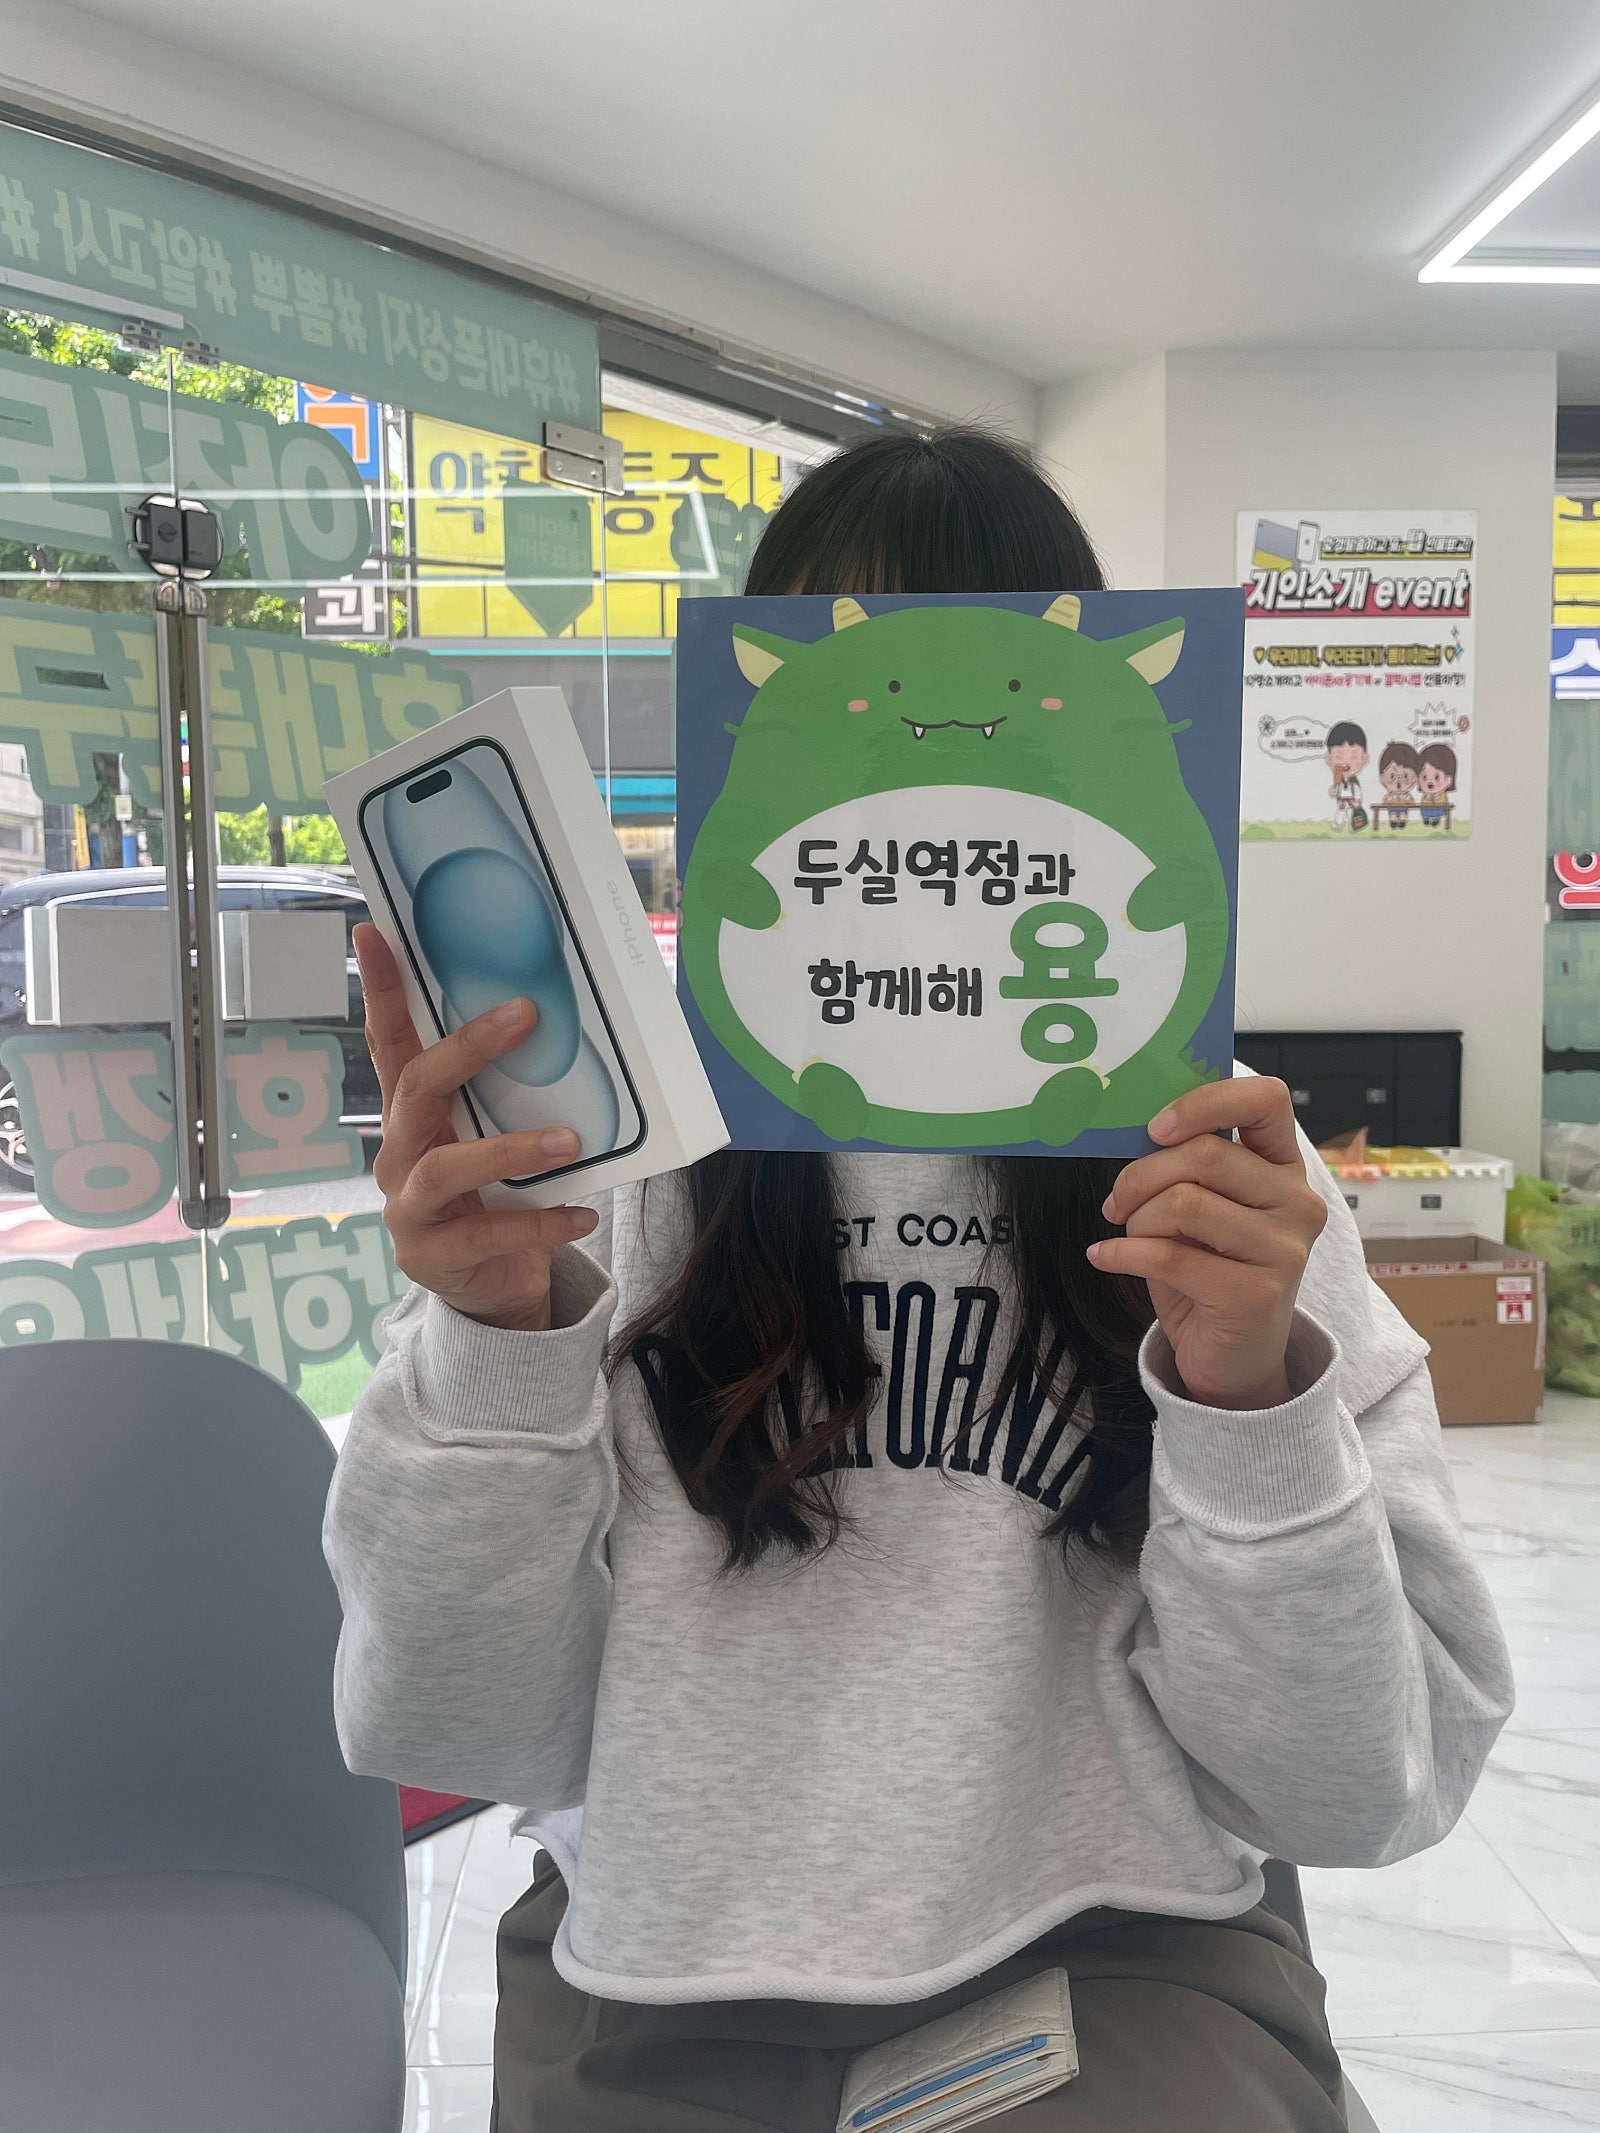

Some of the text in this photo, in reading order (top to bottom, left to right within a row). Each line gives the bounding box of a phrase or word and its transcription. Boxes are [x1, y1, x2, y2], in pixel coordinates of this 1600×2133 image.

[1247, 567, 1470, 611] 지인소개 event
[794, 839, 1076, 905] 두실역점과
[606, 880, 646, 967] iPhone
[832, 1213, 1013, 1249] ST COAS
